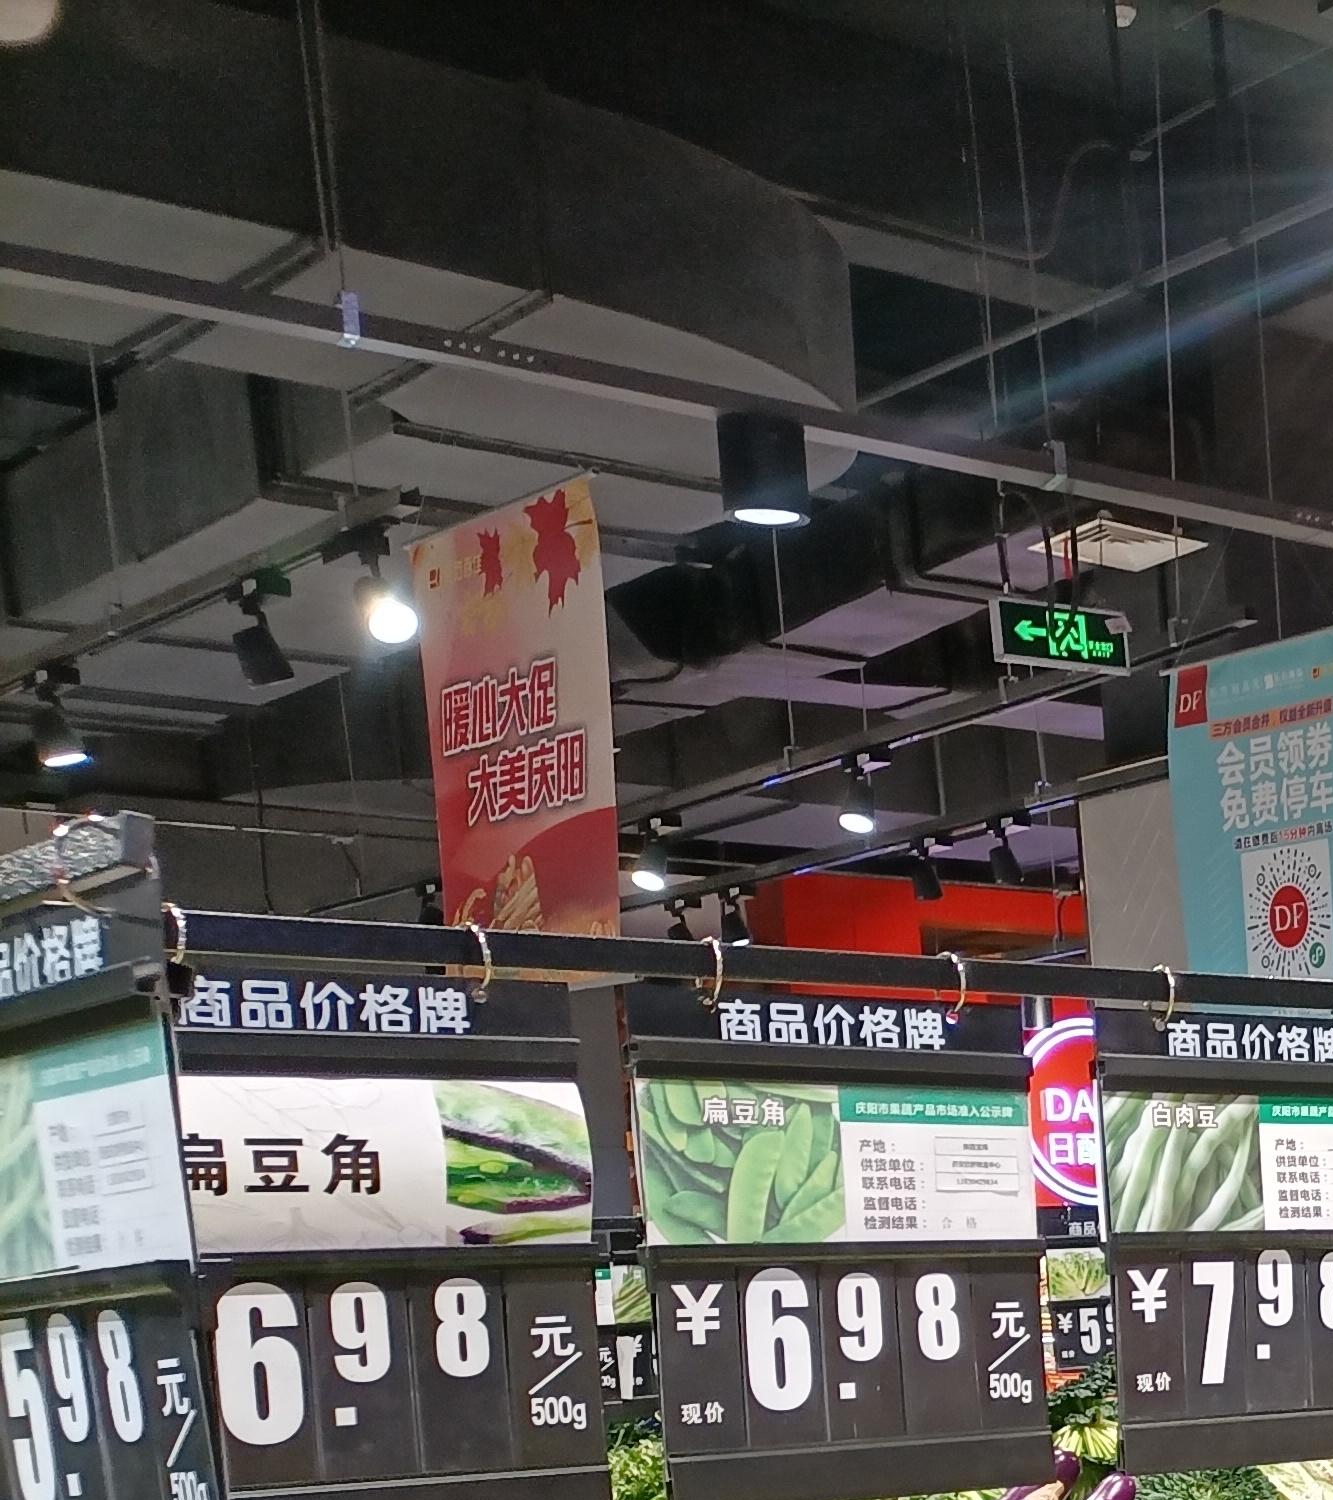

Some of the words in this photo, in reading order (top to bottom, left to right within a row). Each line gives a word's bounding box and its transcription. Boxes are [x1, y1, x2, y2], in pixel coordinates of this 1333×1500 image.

[441, 657, 557, 757] 暖心大促
[467, 730, 586, 827] 大美庆阳
[1216, 719, 1333, 787] 会员领券
[179, 974, 471, 1035] 商品价格牌
[718, 999, 946, 1051] 商品价格牌
[703, 1096, 786, 1126] 扁豆角
[1152, 1104, 1218, 1129] 白肉豆
[182, 1133, 382, 1196] 扁豆角
[1127, 1268, 1168, 1323] ¥
[215, 1277, 490, 1446] 6.98
[671, 1283, 723, 1345] ¥
[745, 1267, 960, 1411] 6.98
[681, 1401, 725, 1424] 现价
[1136, 1371, 1171, 1393] 现价
